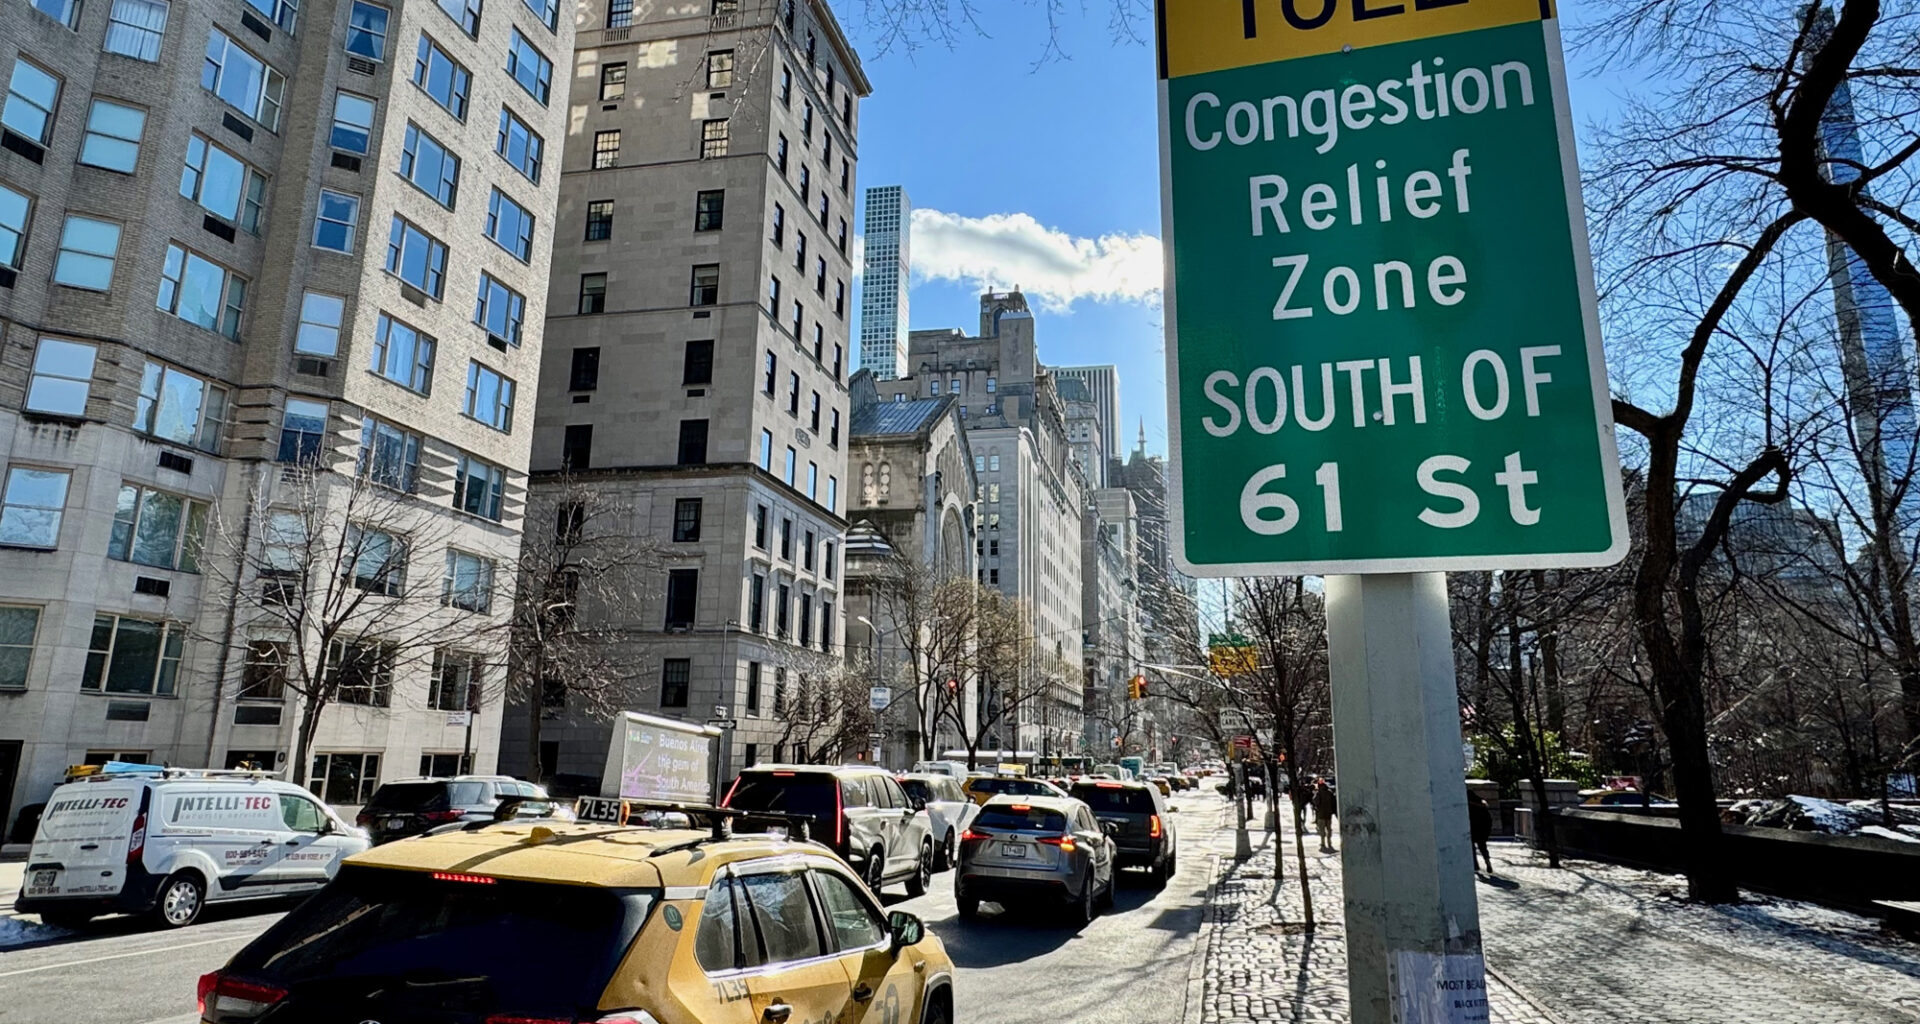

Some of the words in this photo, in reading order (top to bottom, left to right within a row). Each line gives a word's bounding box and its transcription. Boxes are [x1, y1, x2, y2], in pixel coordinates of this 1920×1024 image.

[1185, 57, 1535, 155] Congestion
[1249, 148, 1472, 237] Relief
[1272, 254, 1467, 320] Zone
[1202, 355, 1427, 438] SOUTH
[1461, 344, 1562, 421] OF
[1239, 461, 1343, 536] 61
[1416, 450, 1541, 529] St
[659, 733, 688, 751] Buenos
[689, 738, 710, 755] Aires
[657, 754, 671, 769] the
[672, 759, 690, 772] gem
[690, 760, 700, 771] of
[656, 774, 680, 790] South
[681, 777, 710, 792] America
[47, 797, 129, 821] INTELLI-TEC
[171, 797, 271, 823] INTELLI-TEC
[580, 799, 619, 821] 7L35
[712, 978, 750, 1005] 7L35
[1436, 980, 1464, 991] MOST
